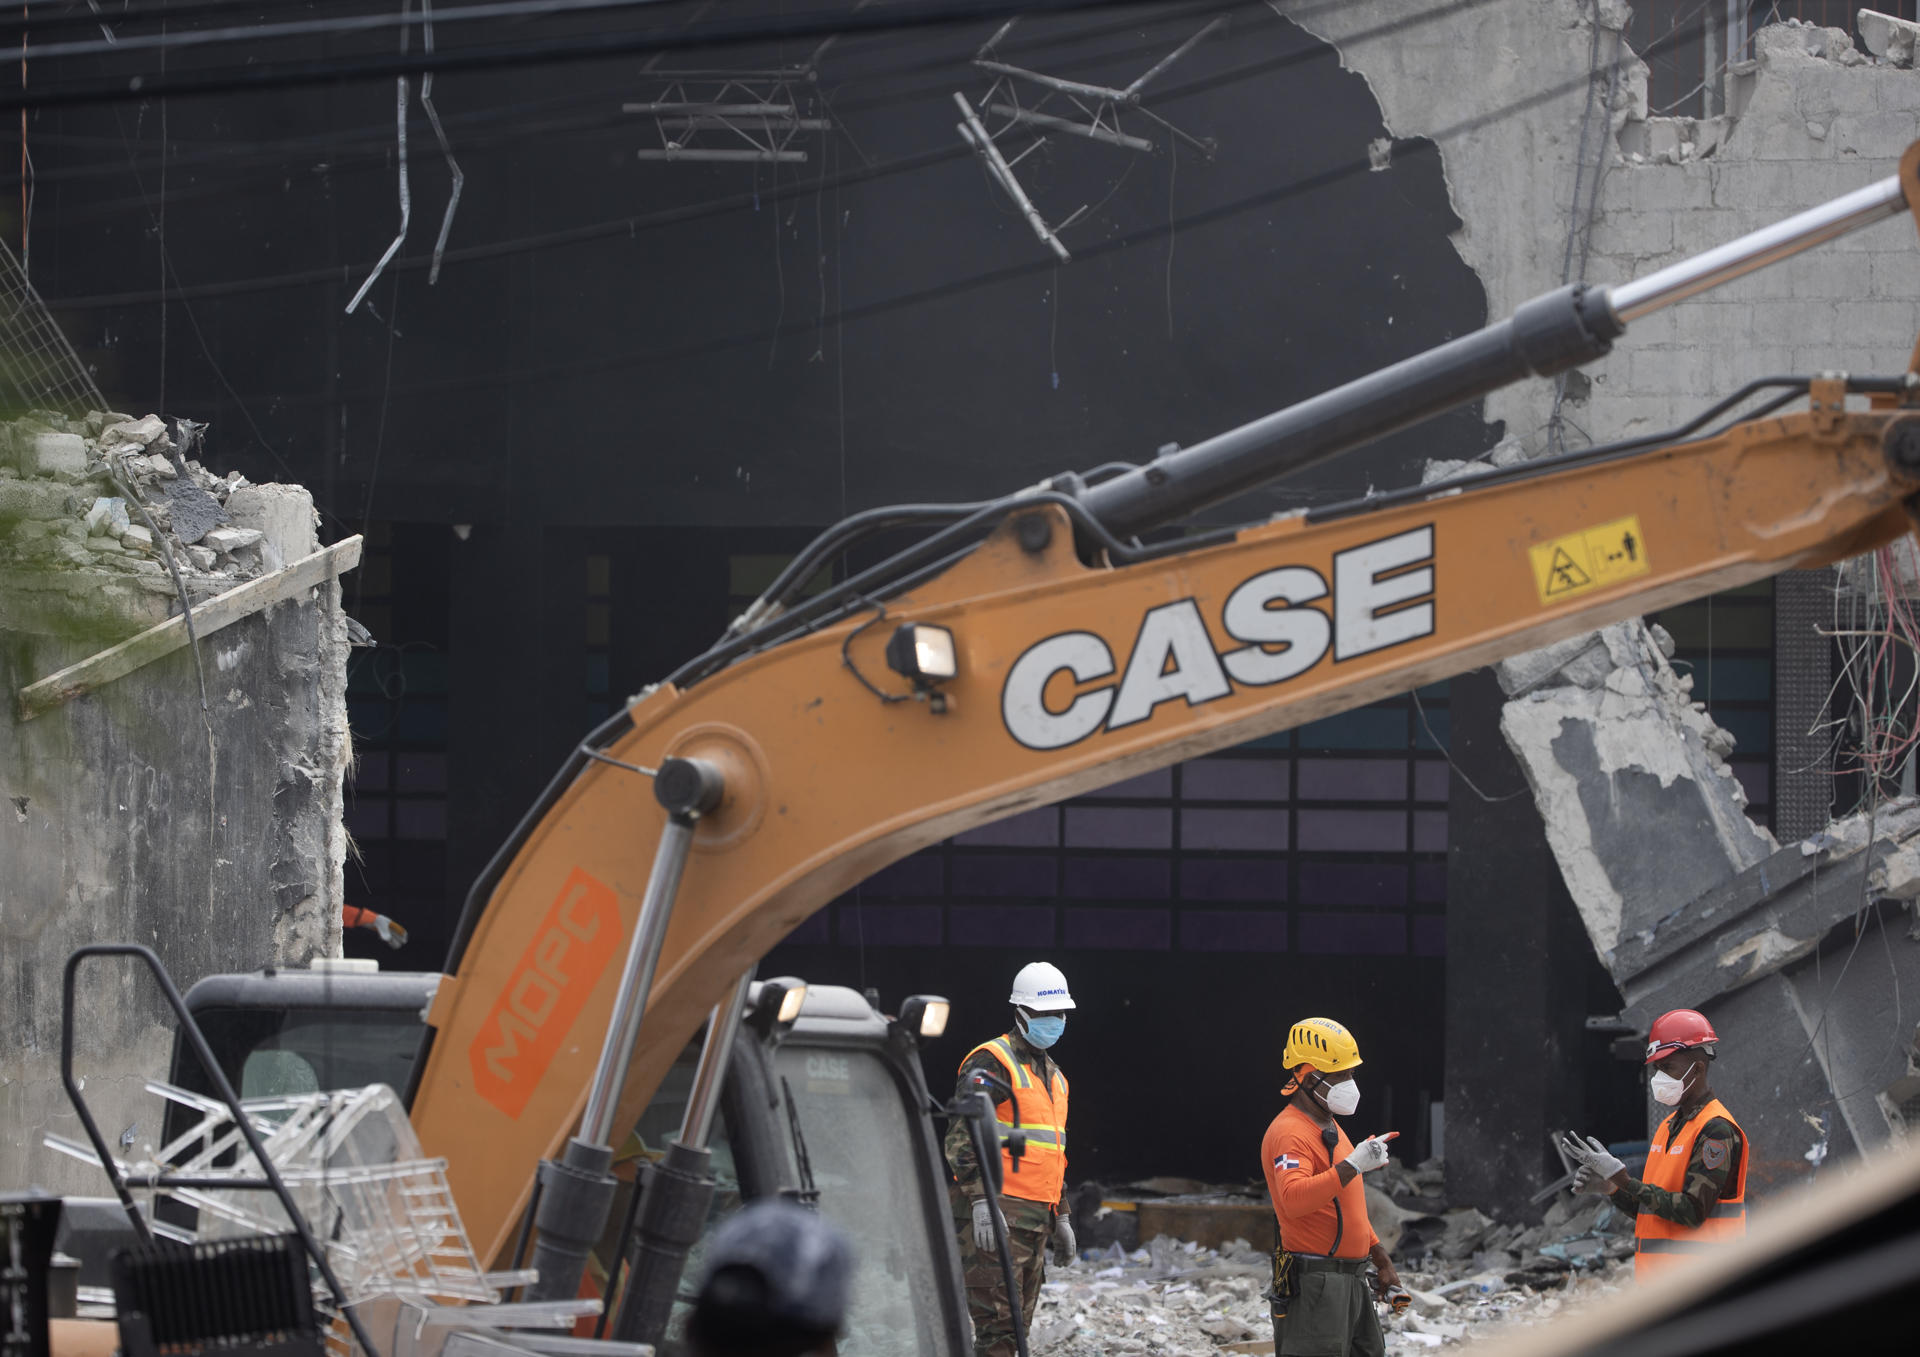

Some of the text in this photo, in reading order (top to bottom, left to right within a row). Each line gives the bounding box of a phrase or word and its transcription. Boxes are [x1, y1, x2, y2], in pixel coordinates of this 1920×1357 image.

[1001, 523, 1435, 750] CASE
[485, 883, 600, 1084] MOPC
[806, 1055, 848, 1080] CASE
